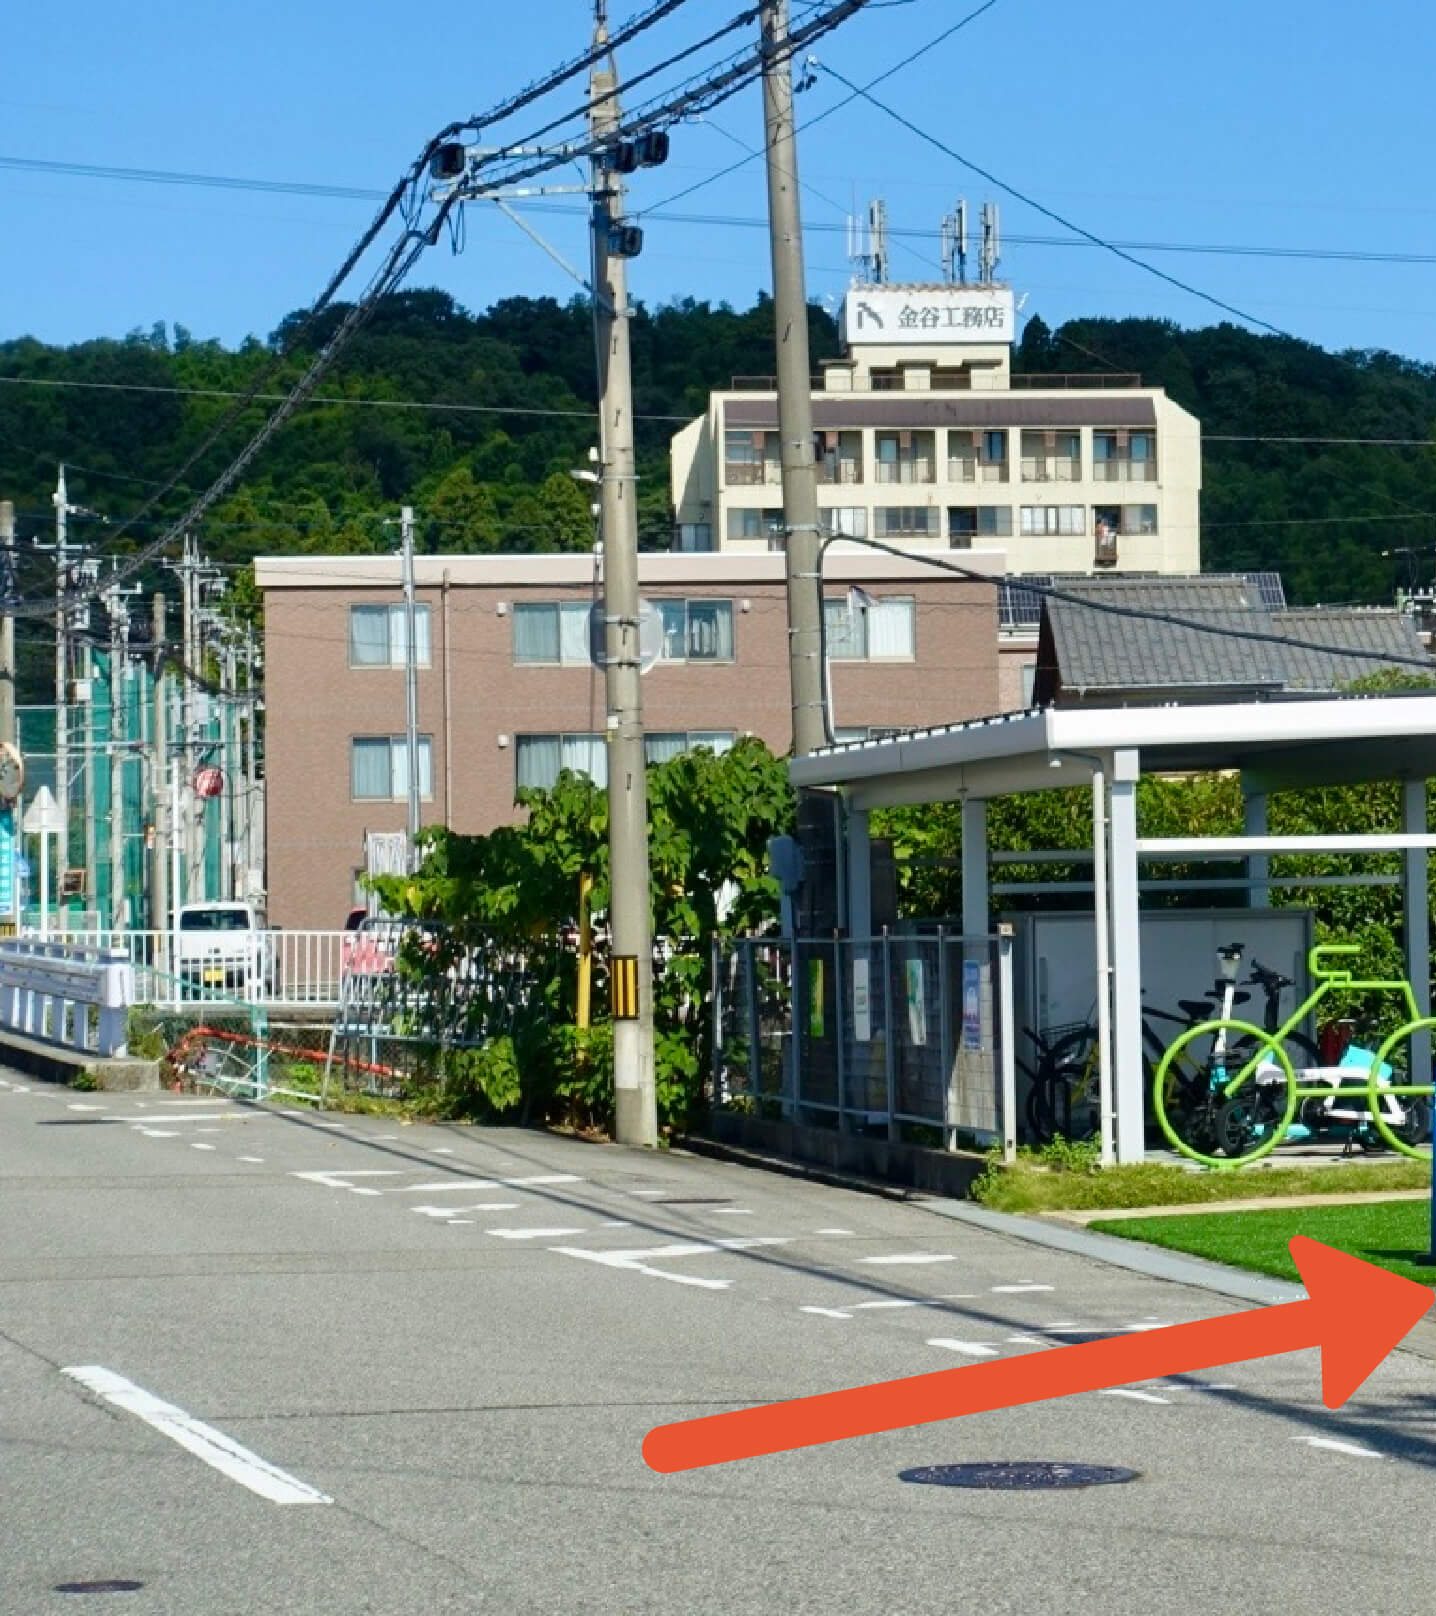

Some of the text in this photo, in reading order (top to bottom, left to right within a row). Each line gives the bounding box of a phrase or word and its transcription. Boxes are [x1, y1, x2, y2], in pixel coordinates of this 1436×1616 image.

[898, 304, 1004, 329] 金谷工務店
